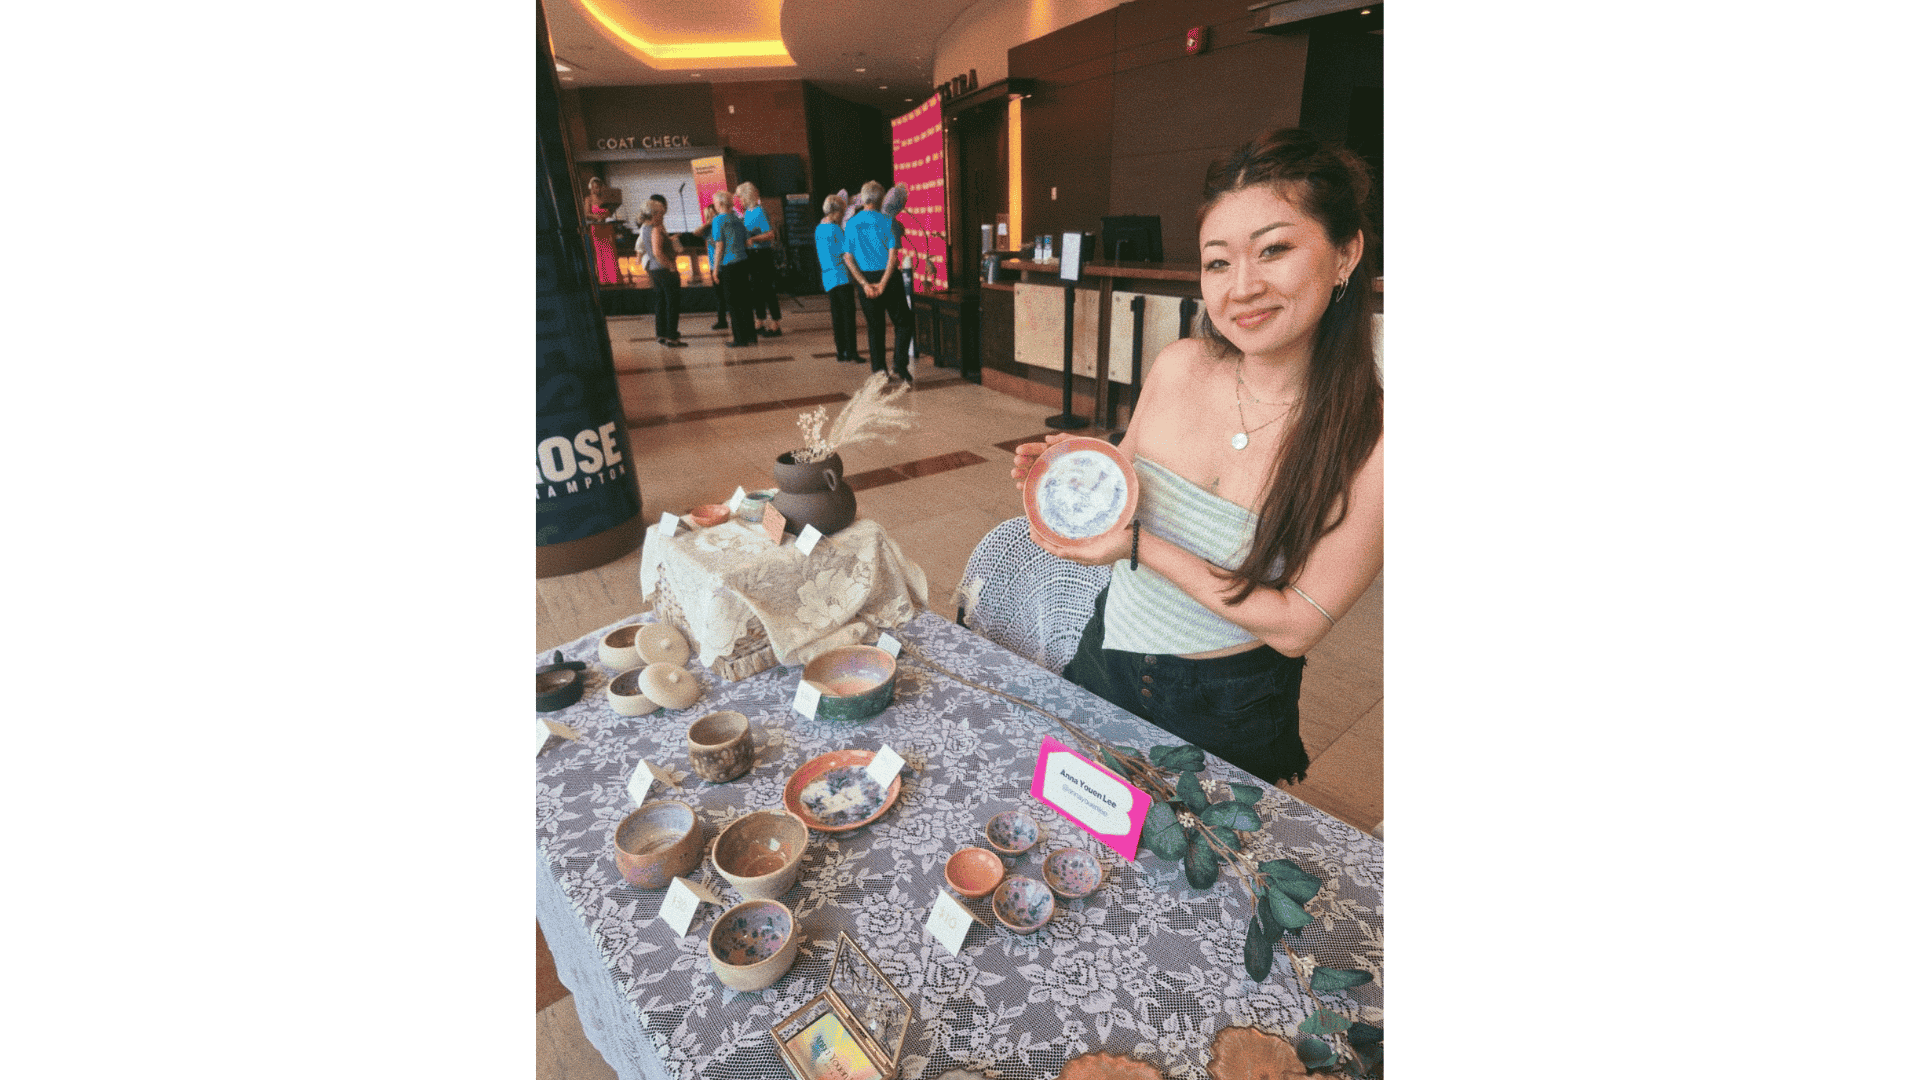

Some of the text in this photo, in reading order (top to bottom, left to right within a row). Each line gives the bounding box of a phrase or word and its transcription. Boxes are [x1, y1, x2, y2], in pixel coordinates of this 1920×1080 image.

[597, 135, 690, 150] COAT CHECK
[536, 421, 622, 485] OSE
[1060, 769, 1117, 808] Anna Youen Lee
